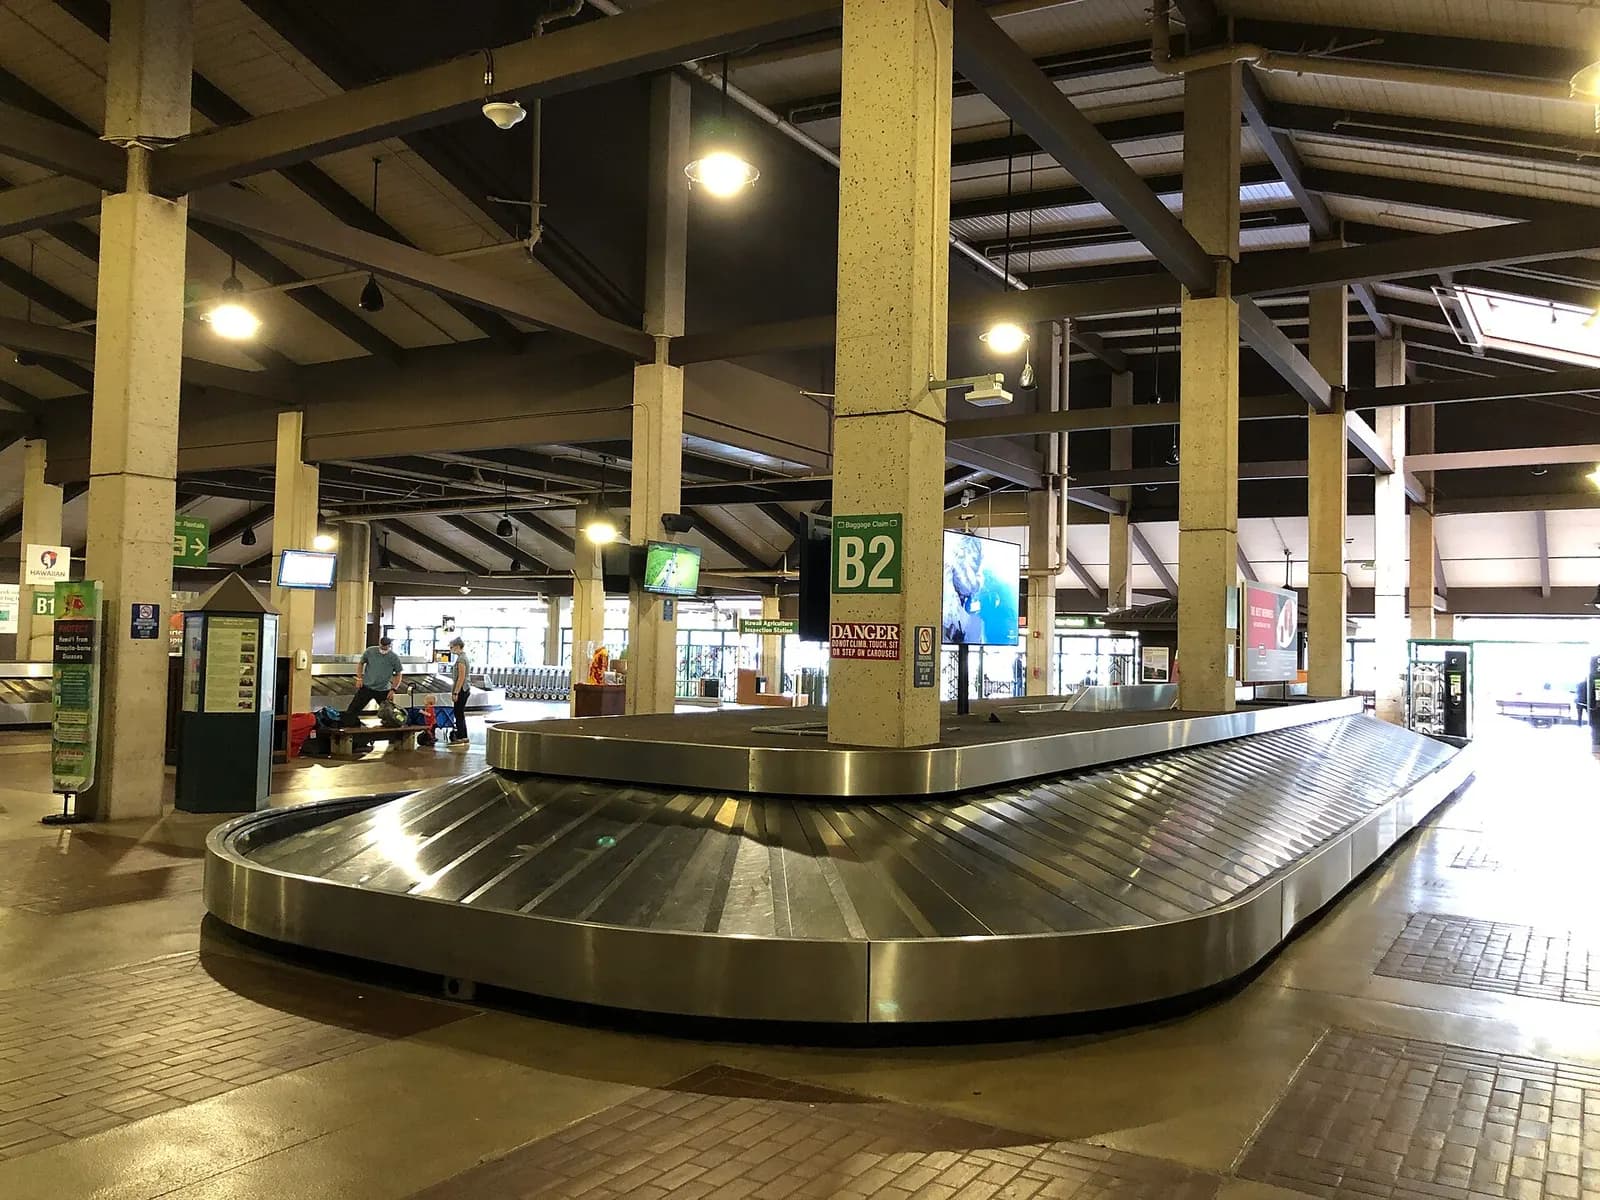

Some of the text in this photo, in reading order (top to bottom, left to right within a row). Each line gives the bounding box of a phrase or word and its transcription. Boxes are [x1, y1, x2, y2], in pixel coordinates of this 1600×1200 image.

[838, 535, 895, 588] B2
[36, 597, 55, 614] B1
[831, 624, 899, 640] DANGER
[832, 648, 898, 658] OR STEP ON CAROUSEL!
[889, 641, 898, 649] SIT
